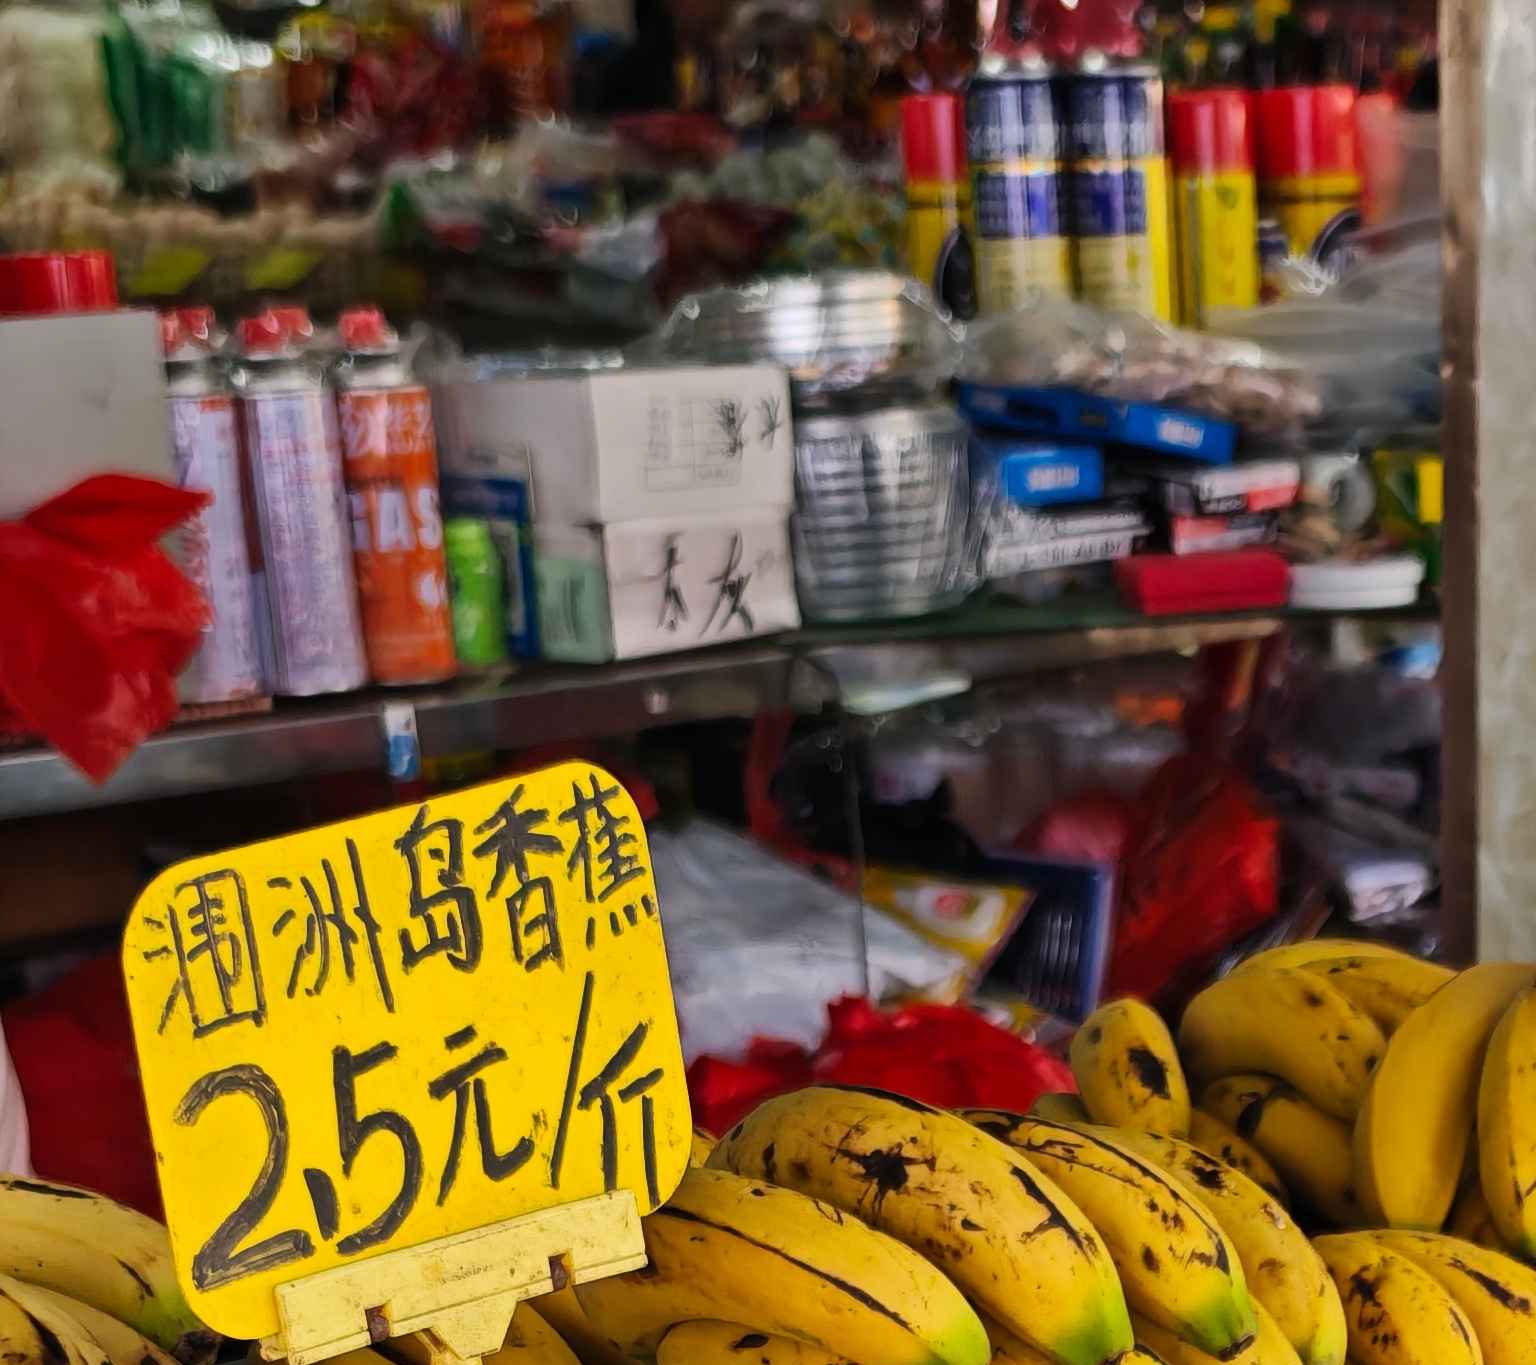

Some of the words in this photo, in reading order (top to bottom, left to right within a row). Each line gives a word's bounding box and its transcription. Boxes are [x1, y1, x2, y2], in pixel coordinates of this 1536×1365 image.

[142, 772, 660, 1040] 涠洲岛香蕉
[173, 970, 667, 1292] 2.5元/斤
